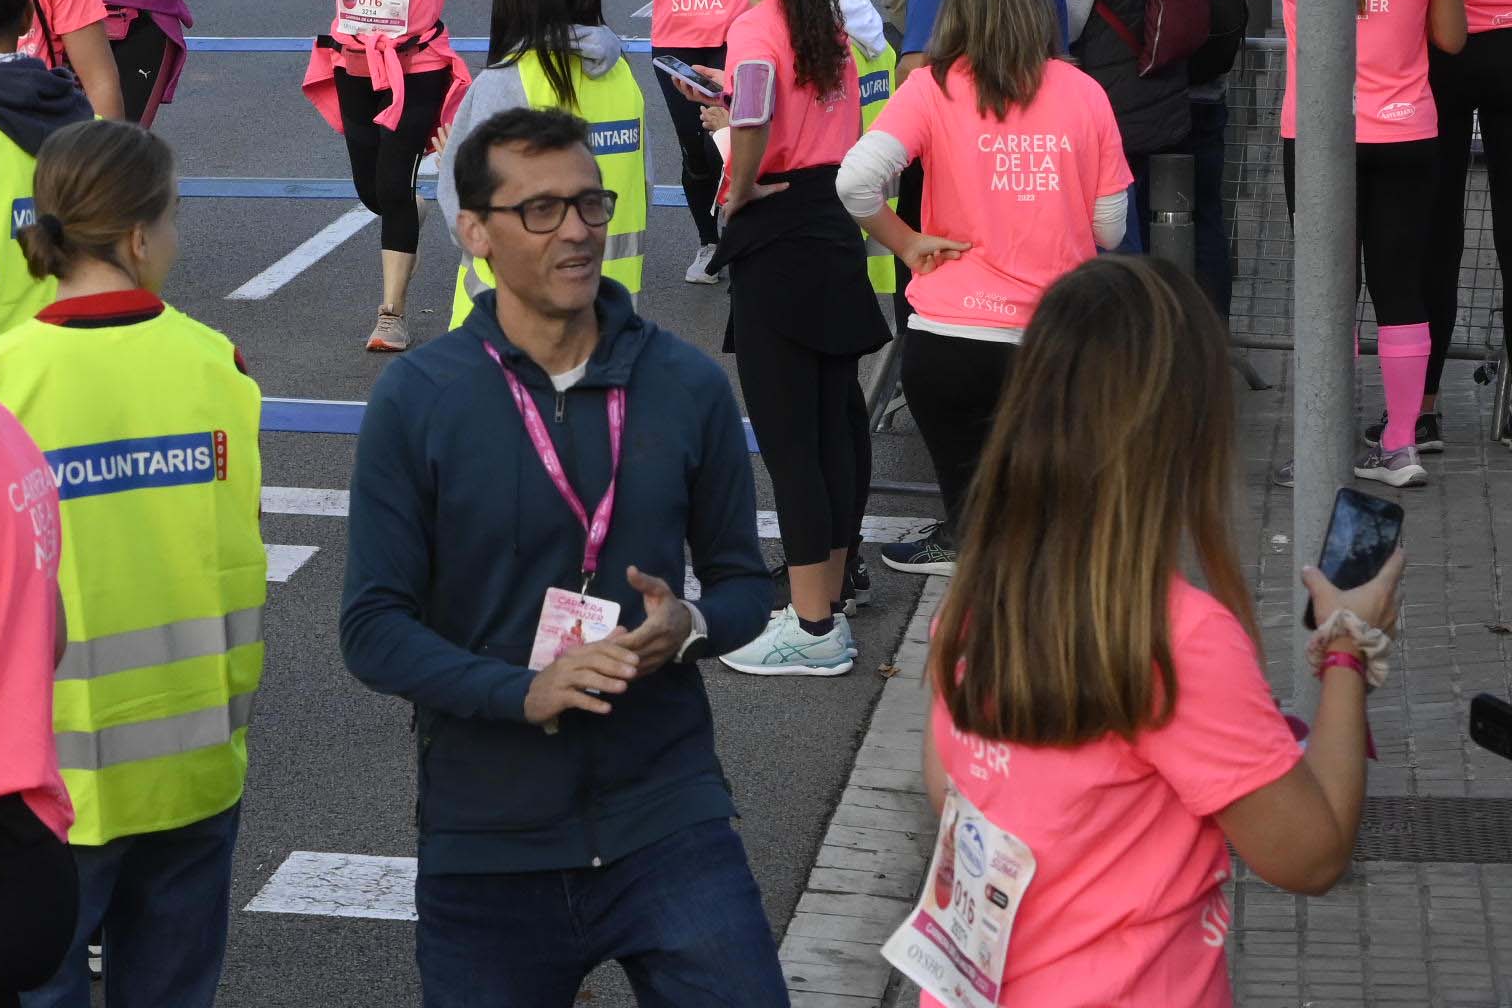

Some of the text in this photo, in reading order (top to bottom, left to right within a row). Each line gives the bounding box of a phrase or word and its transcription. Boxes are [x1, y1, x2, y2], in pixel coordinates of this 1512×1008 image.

[361, 8, 377, 16] 3214
[978, 134, 1072, 153] CARRERA
[996, 153, 1056, 172] DE LA
[991, 173, 1060, 191] MUJER
[963, 295, 1017, 317] OYSHO
[52, 445, 211, 489] VOLUNTARIS
[557, 596, 603, 613] CARRERA
[570, 607, 604, 624] MUJER
[954, 882, 976, 925] 016
